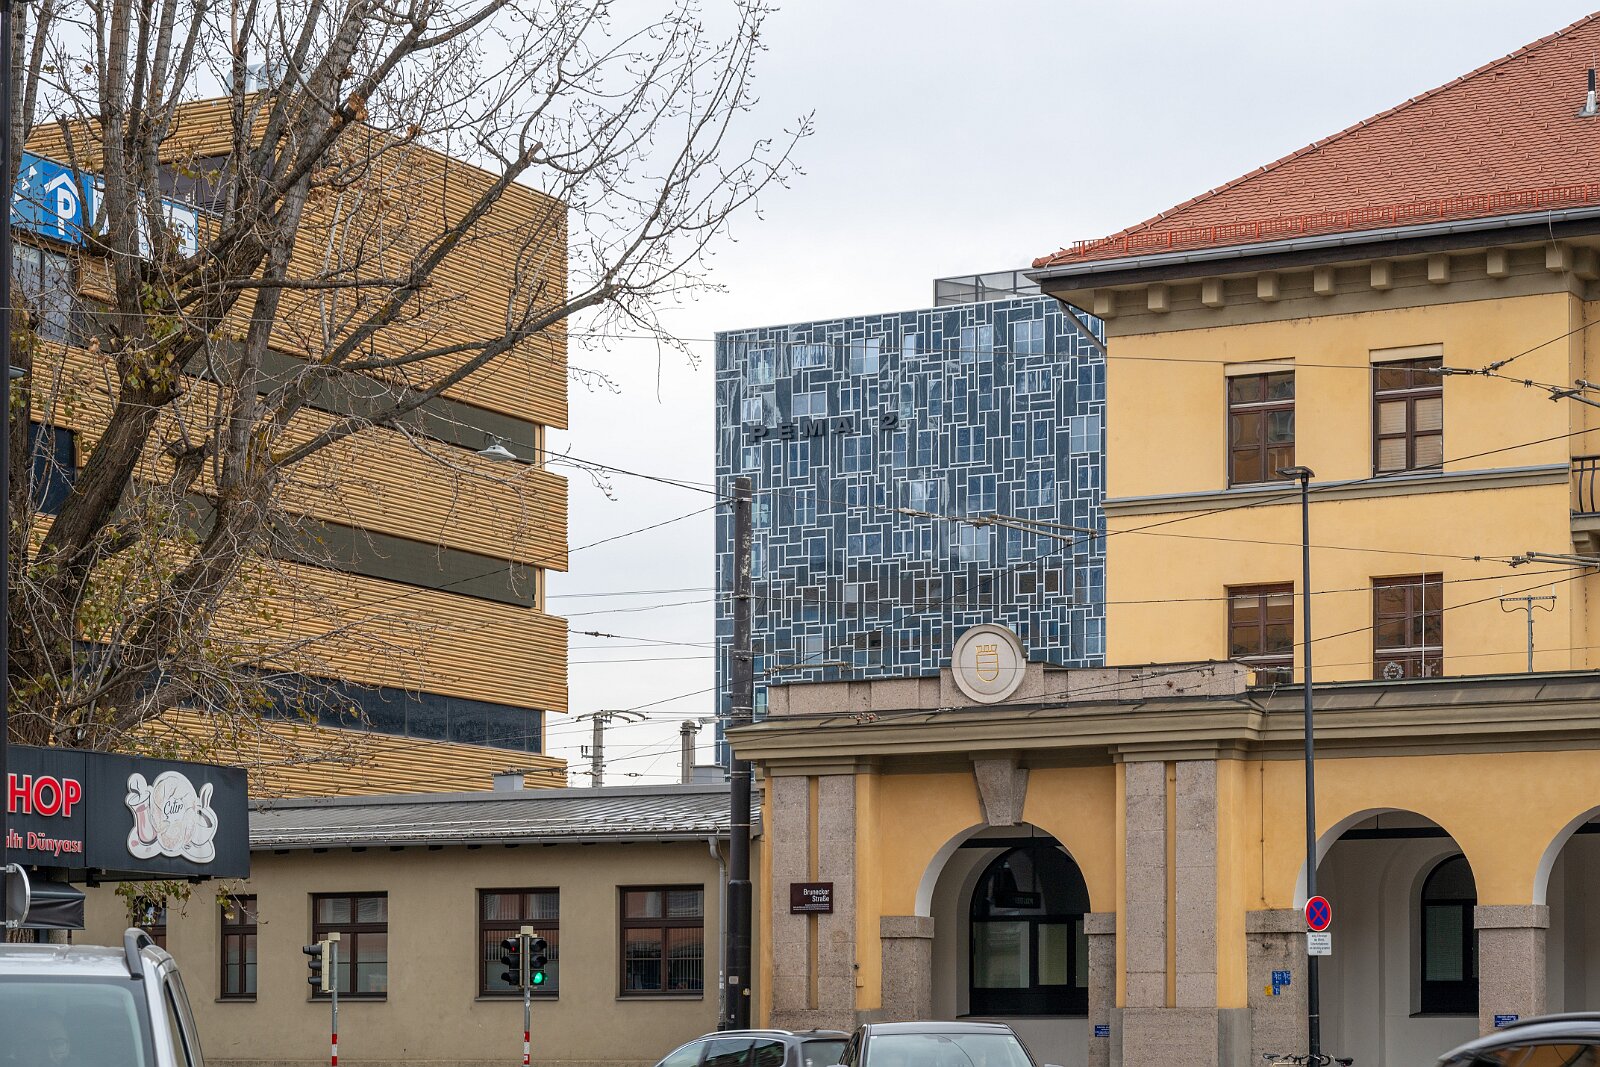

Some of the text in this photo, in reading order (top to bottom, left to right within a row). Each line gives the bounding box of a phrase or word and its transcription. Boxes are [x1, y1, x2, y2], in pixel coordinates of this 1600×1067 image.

[57, 187, 76, 236] P
[750, 412, 898, 442] PEMA 2
[27, 831, 83, 857] Dünyası
